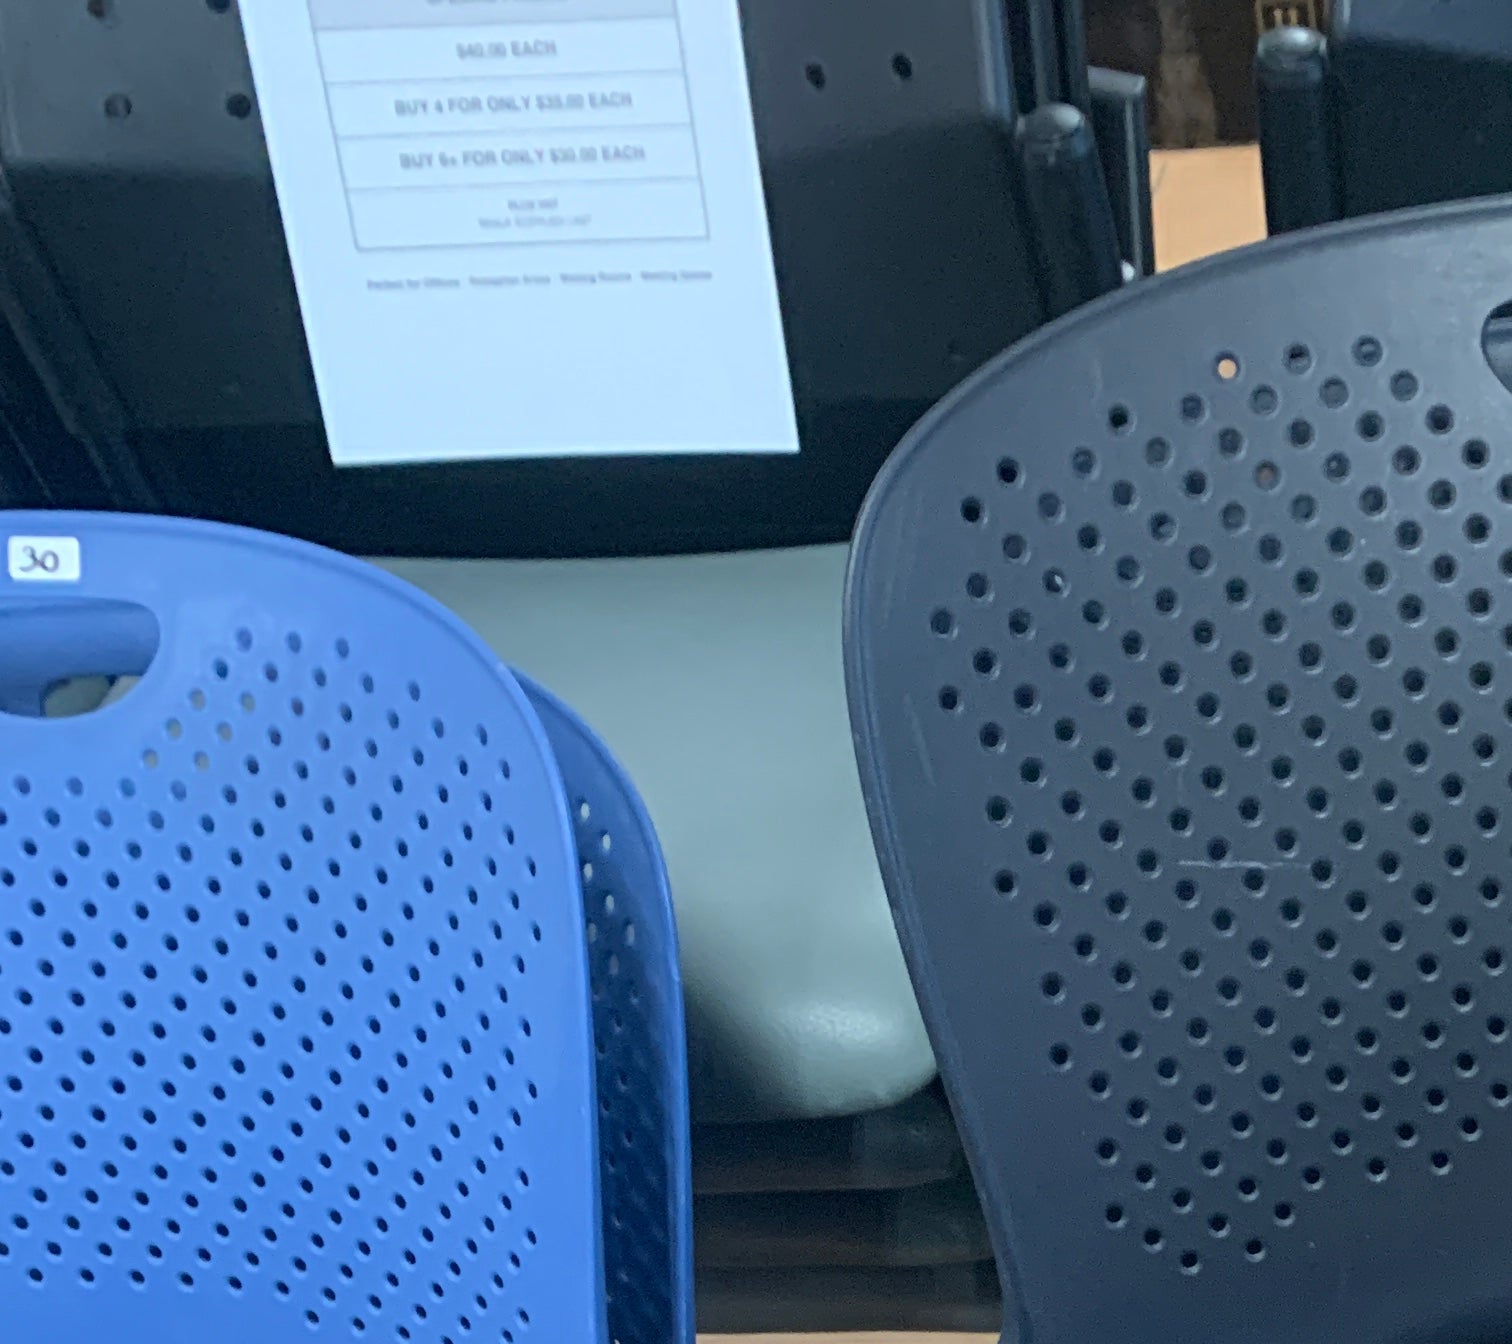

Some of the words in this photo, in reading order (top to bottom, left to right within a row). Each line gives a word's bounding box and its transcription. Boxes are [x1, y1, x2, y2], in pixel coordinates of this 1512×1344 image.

[510, 39, 557, 57] EACH
[394, 99, 428, 117] BUY
[447, 96, 483, 114] FOR
[487, 95, 530, 113] ONLY
[588, 91, 633, 109] EACH
[400, 152, 433, 170] BUY
[462, 150, 497, 167] FOR
[501, 148, 544, 167] ONLY
[601, 145, 646, 163] EACH
[19, 545, 60, 573] 30
